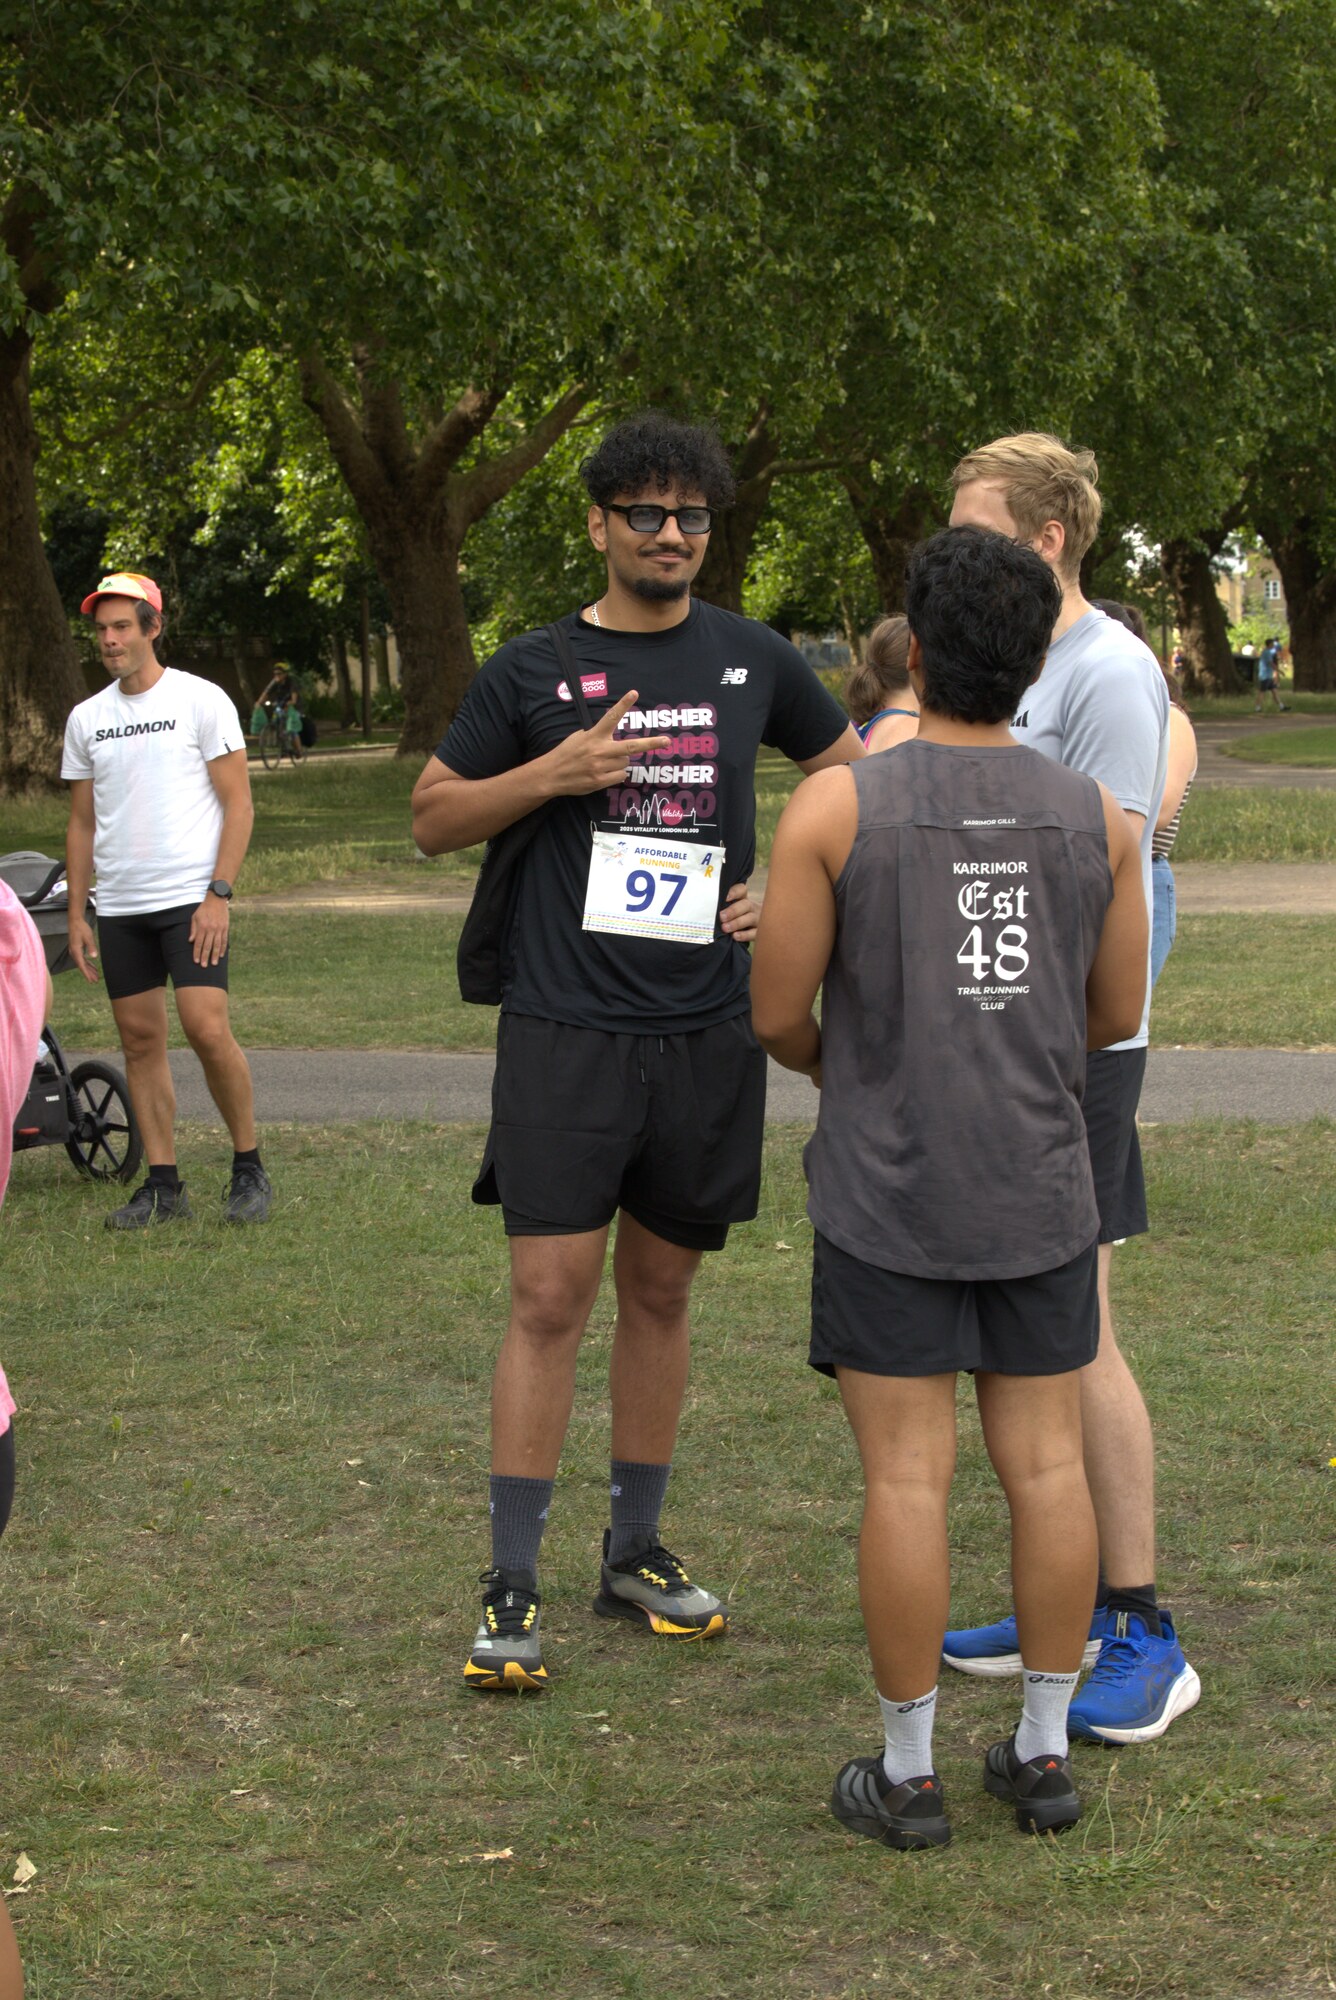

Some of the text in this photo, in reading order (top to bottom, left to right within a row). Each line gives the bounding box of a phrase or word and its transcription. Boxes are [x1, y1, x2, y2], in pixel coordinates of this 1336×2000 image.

[617, 708, 713, 730] FINISHER
[95, 719, 176, 742] SALOMON
[623, 765, 714, 783] FINISHER
[661, 808, 684, 820] Vitality
[634, 847, 688, 861] AFFORDABLE
[701, 852, 713, 866] A
[639, 857, 681, 870] RUNNING
[953, 861, 1029, 875] KARRIMOR
[704, 864, 714, 878] R
[625, 869, 688, 916] 97
[958, 880, 1029, 920] Est
[957, 924, 1029, 981] 48
[957, 986, 1030, 996] TRAIL RUNNING
[980, 1002, 1005, 1011] CLUB
